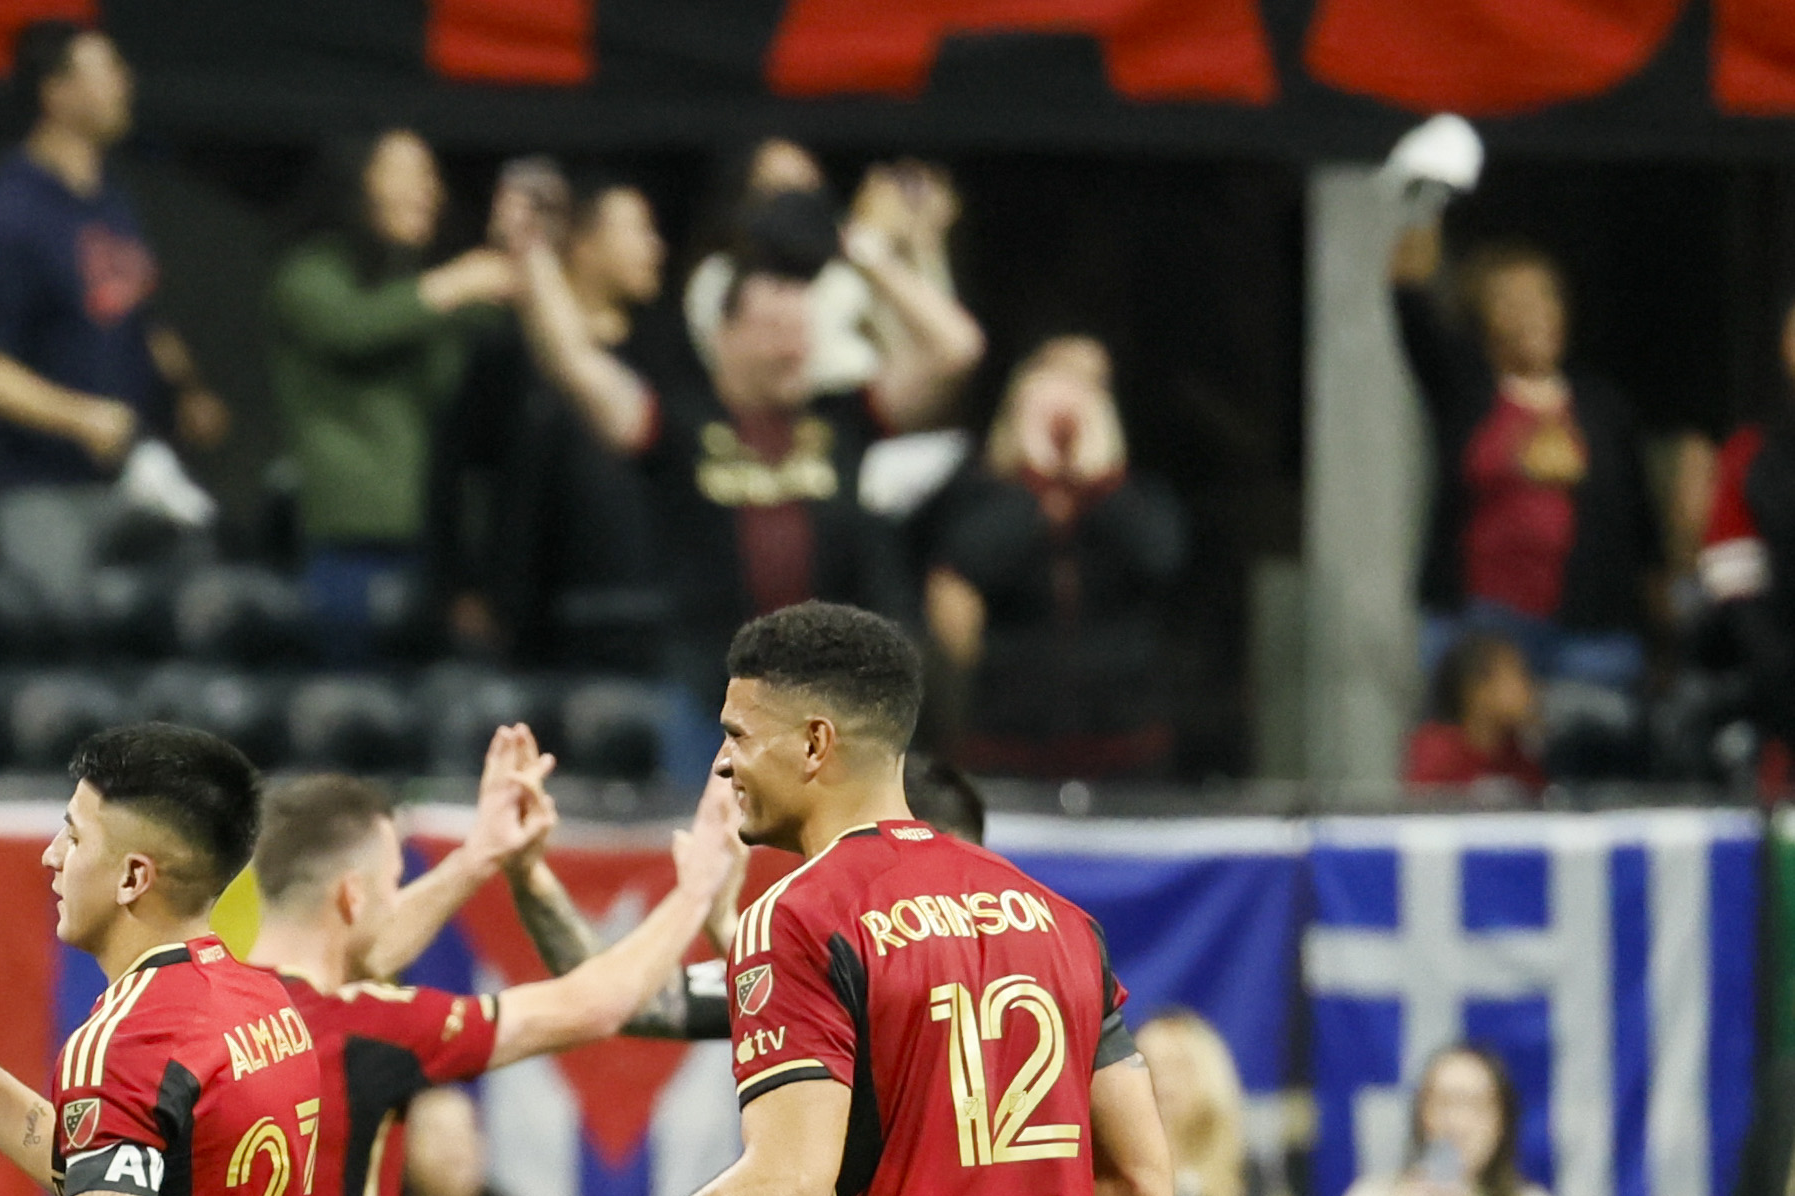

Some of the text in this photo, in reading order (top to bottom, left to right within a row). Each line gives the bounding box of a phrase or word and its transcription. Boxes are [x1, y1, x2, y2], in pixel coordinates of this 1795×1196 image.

[860, 890, 1057, 956] ROBINSON
[754, 1025, 786, 1056] tv
[931, 974, 1081, 1167] 12
